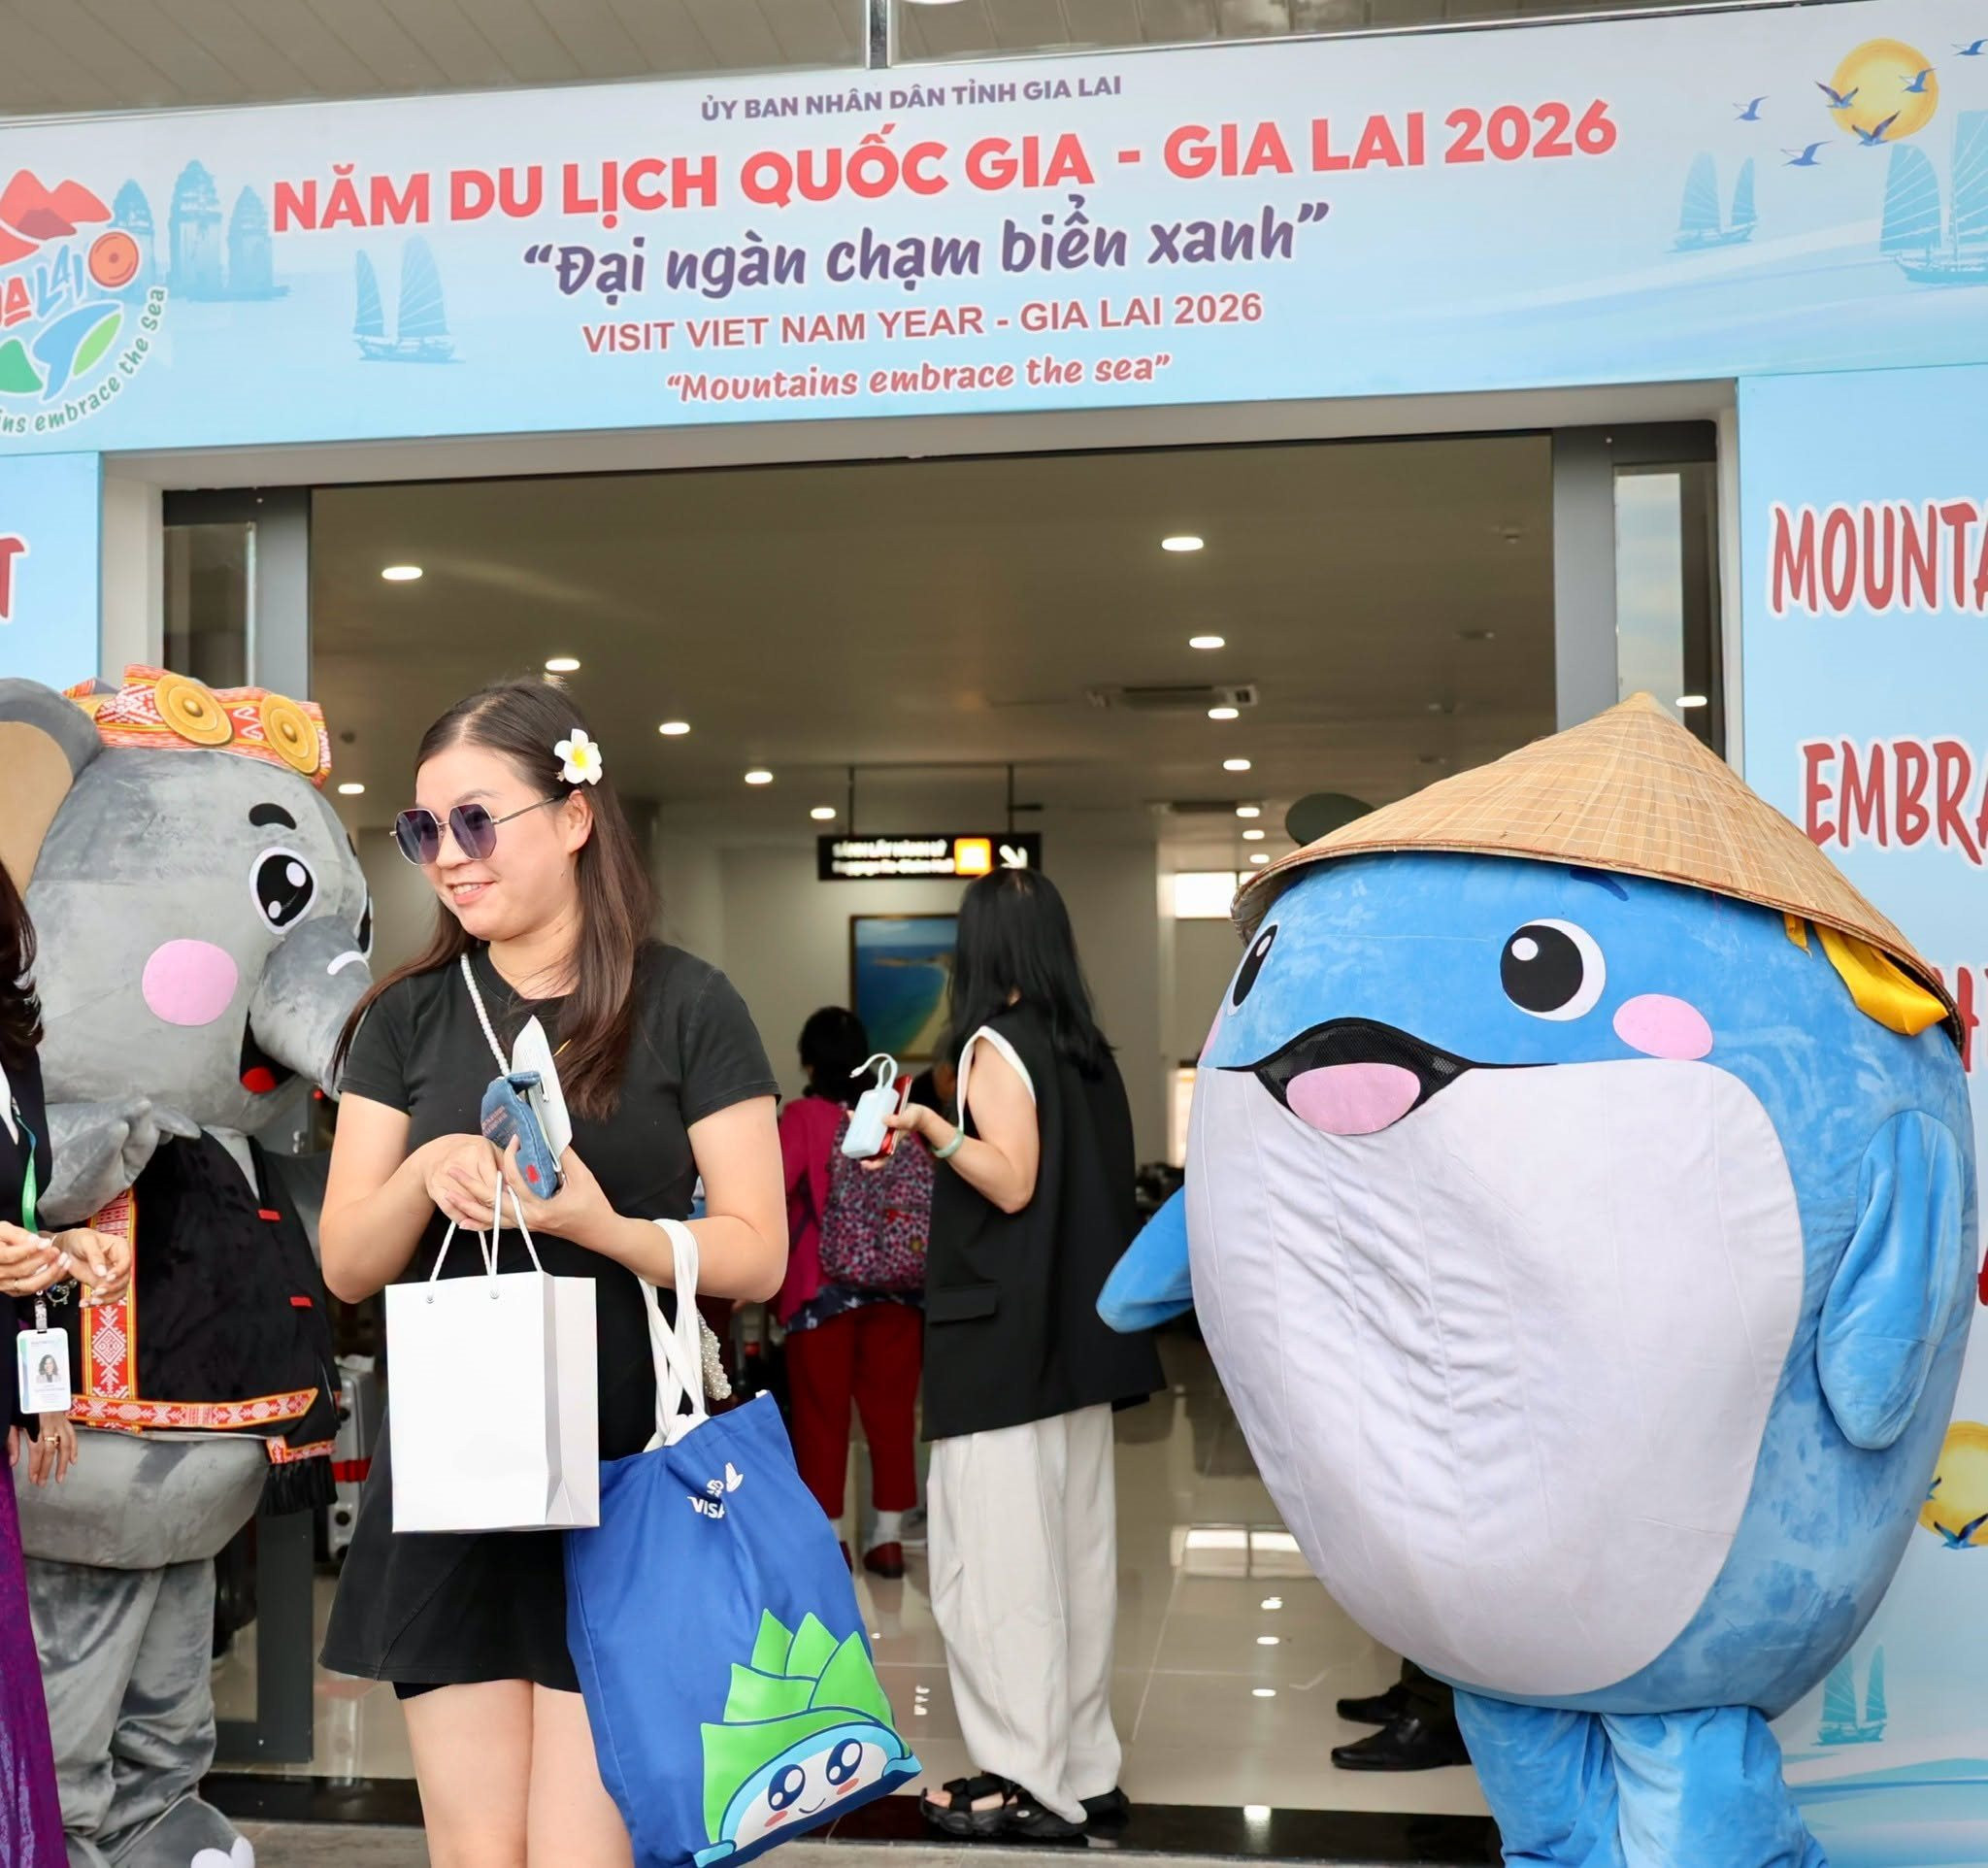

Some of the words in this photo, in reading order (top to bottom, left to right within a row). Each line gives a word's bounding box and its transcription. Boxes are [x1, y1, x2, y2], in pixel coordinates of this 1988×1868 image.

[702, 91, 738, 121] ỦY
[745, 95, 799, 118] BAN
[806, 89, 882, 116] NHÂN
[889, 84, 945, 111] DÂN
[951, 79, 1016, 105] TỈNH
[1023, 79, 1072, 101] GIA
[1078, 75, 1121, 97] LAI
[274, 163, 430, 233] NĂM
[449, 165, 544, 221] DU
[562, 155, 717, 229] LỊCH
[741, 122, 949, 208] QUỐC
[965, 133, 1095, 191] GIA
[1118, 150, 1142, 163] -
[1164, 121, 1293, 179] GIA
[1312, 112, 1426, 172] LAI
[1444, 99, 1617, 164] 2026
[0, 277, 32, 327] A
[37, 244, 83, 320] LAI
[524, 237, 645, 305] “Đại
[667, 230, 805, 298] ngàn
[827, 227, 979, 290] chạm
[1003, 194, 1126, 272] biển
[1148, 203, 1329, 263] xanh”
[0, 409, 26, 433] ns
[35, 377, 120, 433] embrace
[118, 338, 149, 375] the
[141, 289, 165, 331] sea
[583, 321, 674, 352] VISIT
[686, 317, 769, 348] VIET
[782, 313, 866, 343] NAM
[878, 306, 983, 338] YEAR
[1020, 301, 1088, 332] GIA
[1100, 297, 1162, 327] LAI
[1176, 292, 1263, 324] 2026
[668, 367, 858, 400] “Mountains
[870, 364, 1014, 394] embrace
[1027, 356, 1082, 384] the
[1097, 354, 1171, 382] sea”
